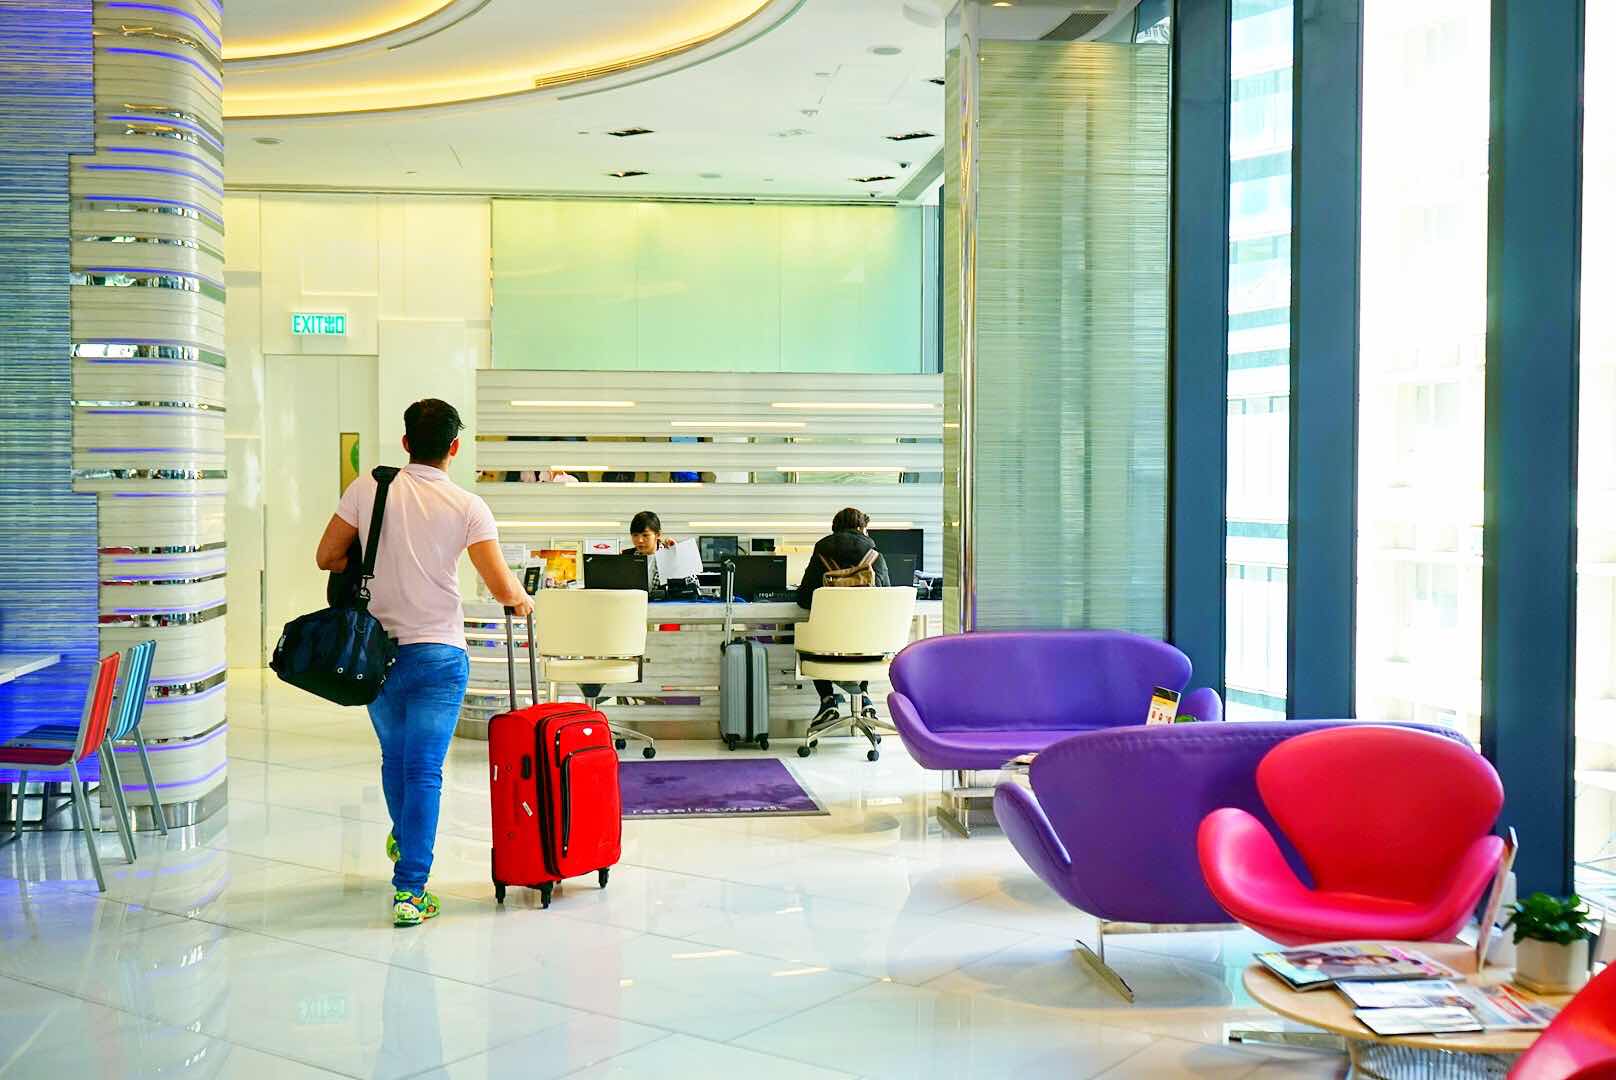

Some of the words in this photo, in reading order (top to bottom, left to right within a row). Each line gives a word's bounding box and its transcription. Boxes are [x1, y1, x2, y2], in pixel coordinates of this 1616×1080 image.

[293, 315, 324, 333] EXIT
[324, 315, 345, 334] 出口
[758, 591, 774, 599] regal
